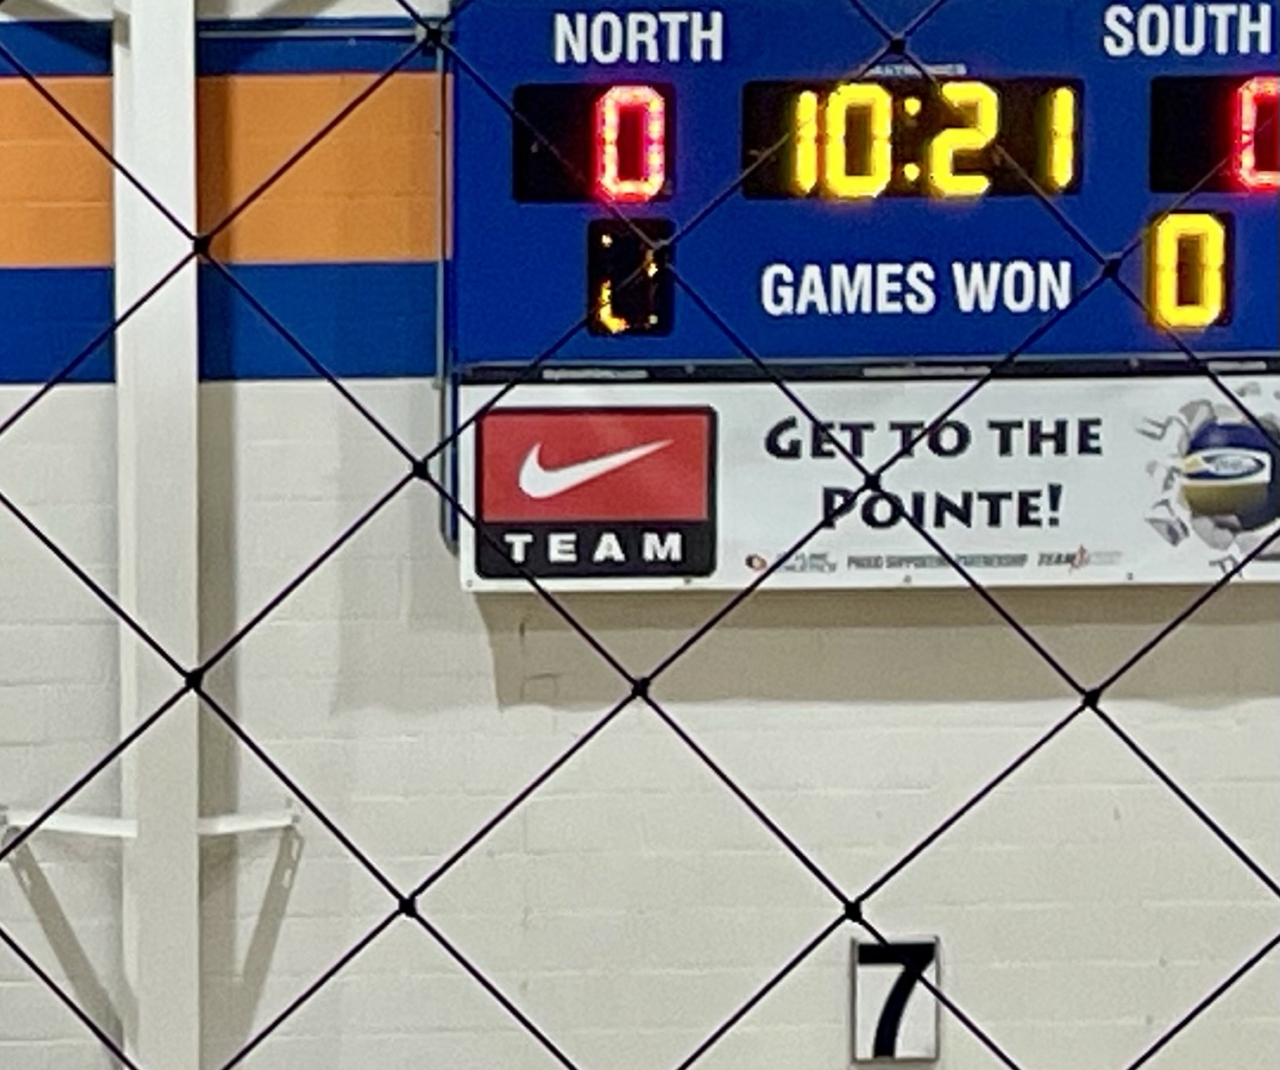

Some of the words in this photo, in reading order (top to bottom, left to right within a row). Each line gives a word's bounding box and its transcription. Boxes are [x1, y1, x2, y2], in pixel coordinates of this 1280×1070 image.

[555, 11, 723, 64] NORTH
[1104, 3, 1271, 56] SOUTH
[596, 84, 665, 200] 0
[795, 81, 1076, 198] 10:21
[762, 261, 937, 316] GAMES
[951, 260, 1072, 313] WON
[1154, 213, 1226, 328] 0
[765, 416, 875, 459] GET
[889, 419, 971, 457] TO
[987, 418, 1103, 456] THE
[822, 483, 1063, 529] POINTE!
[504, 532, 683, 564] TEAM
[858, 943, 936, 1058] 7
